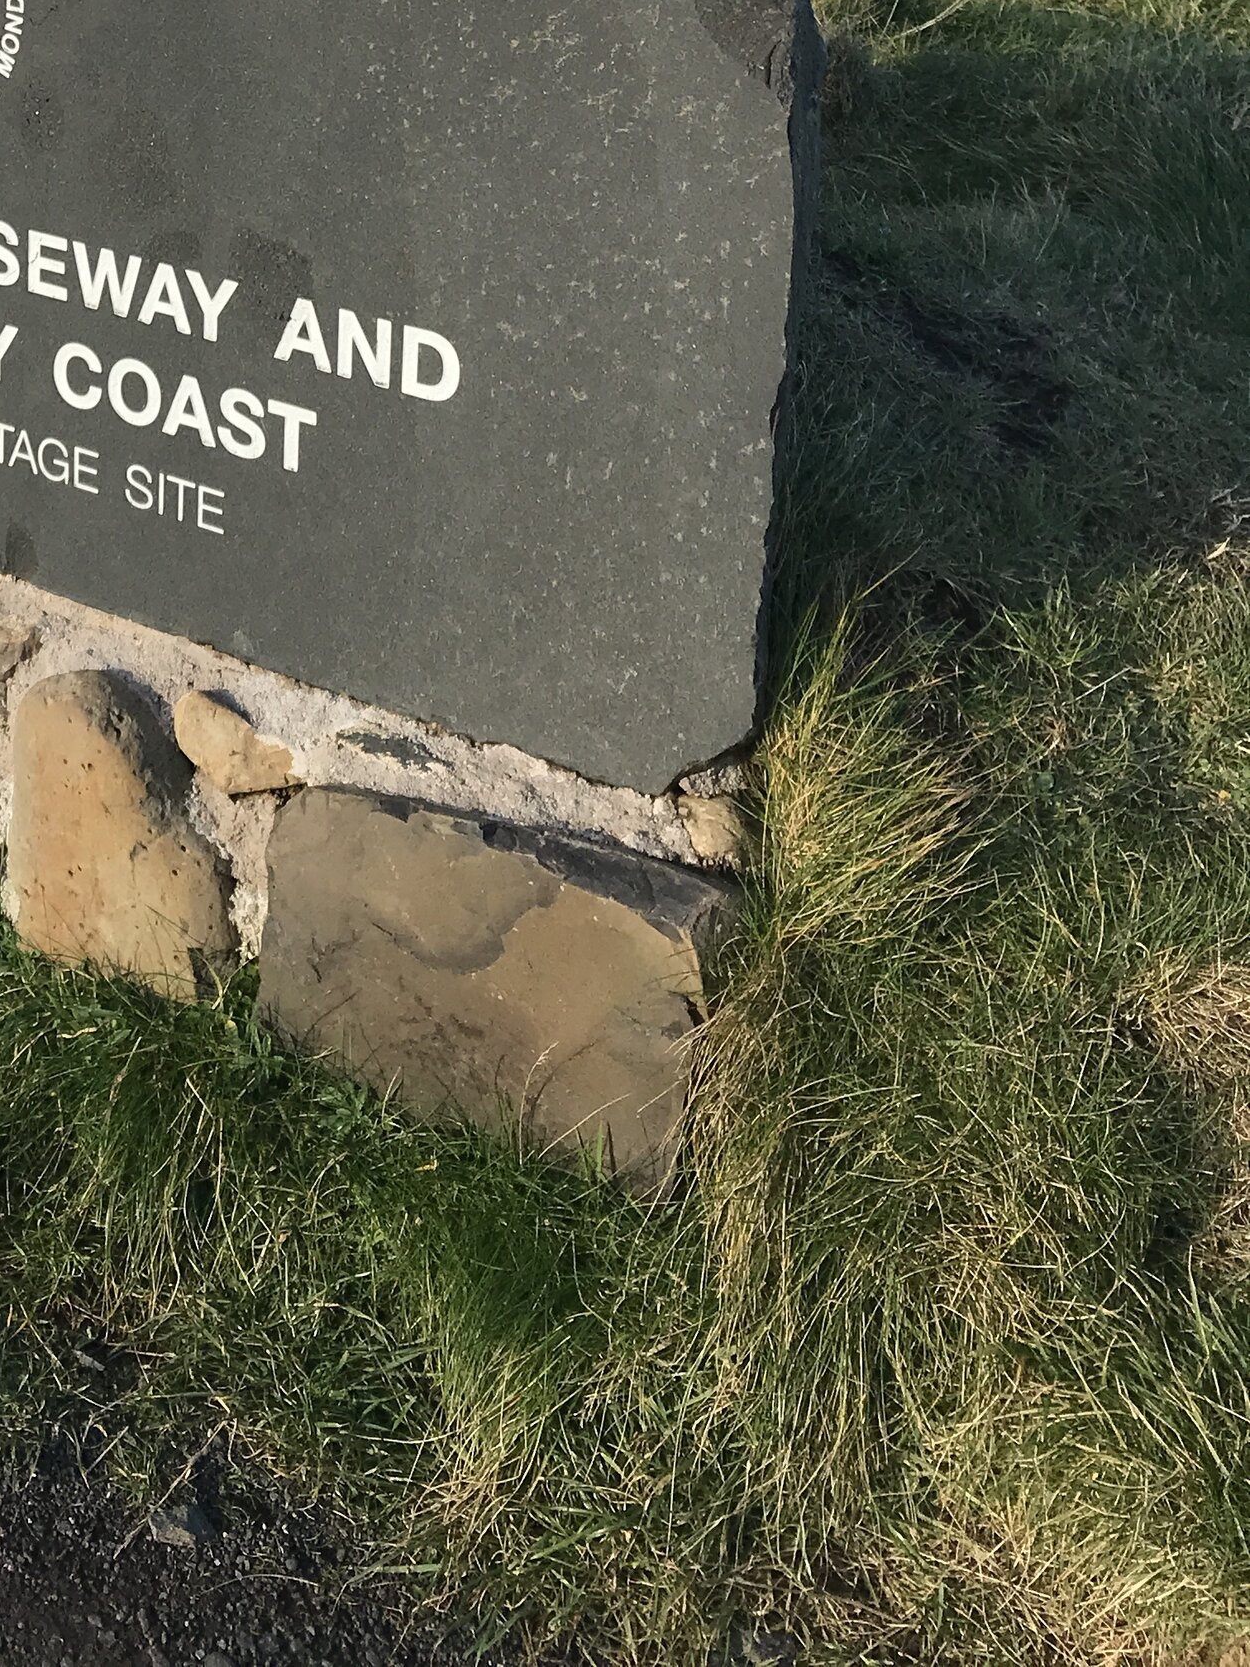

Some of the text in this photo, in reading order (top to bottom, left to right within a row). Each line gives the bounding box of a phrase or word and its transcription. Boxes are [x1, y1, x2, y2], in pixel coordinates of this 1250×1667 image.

[275, 296, 462, 402] AND
[52, 343, 318, 472] COAST
[125, 463, 226, 534] SITE
